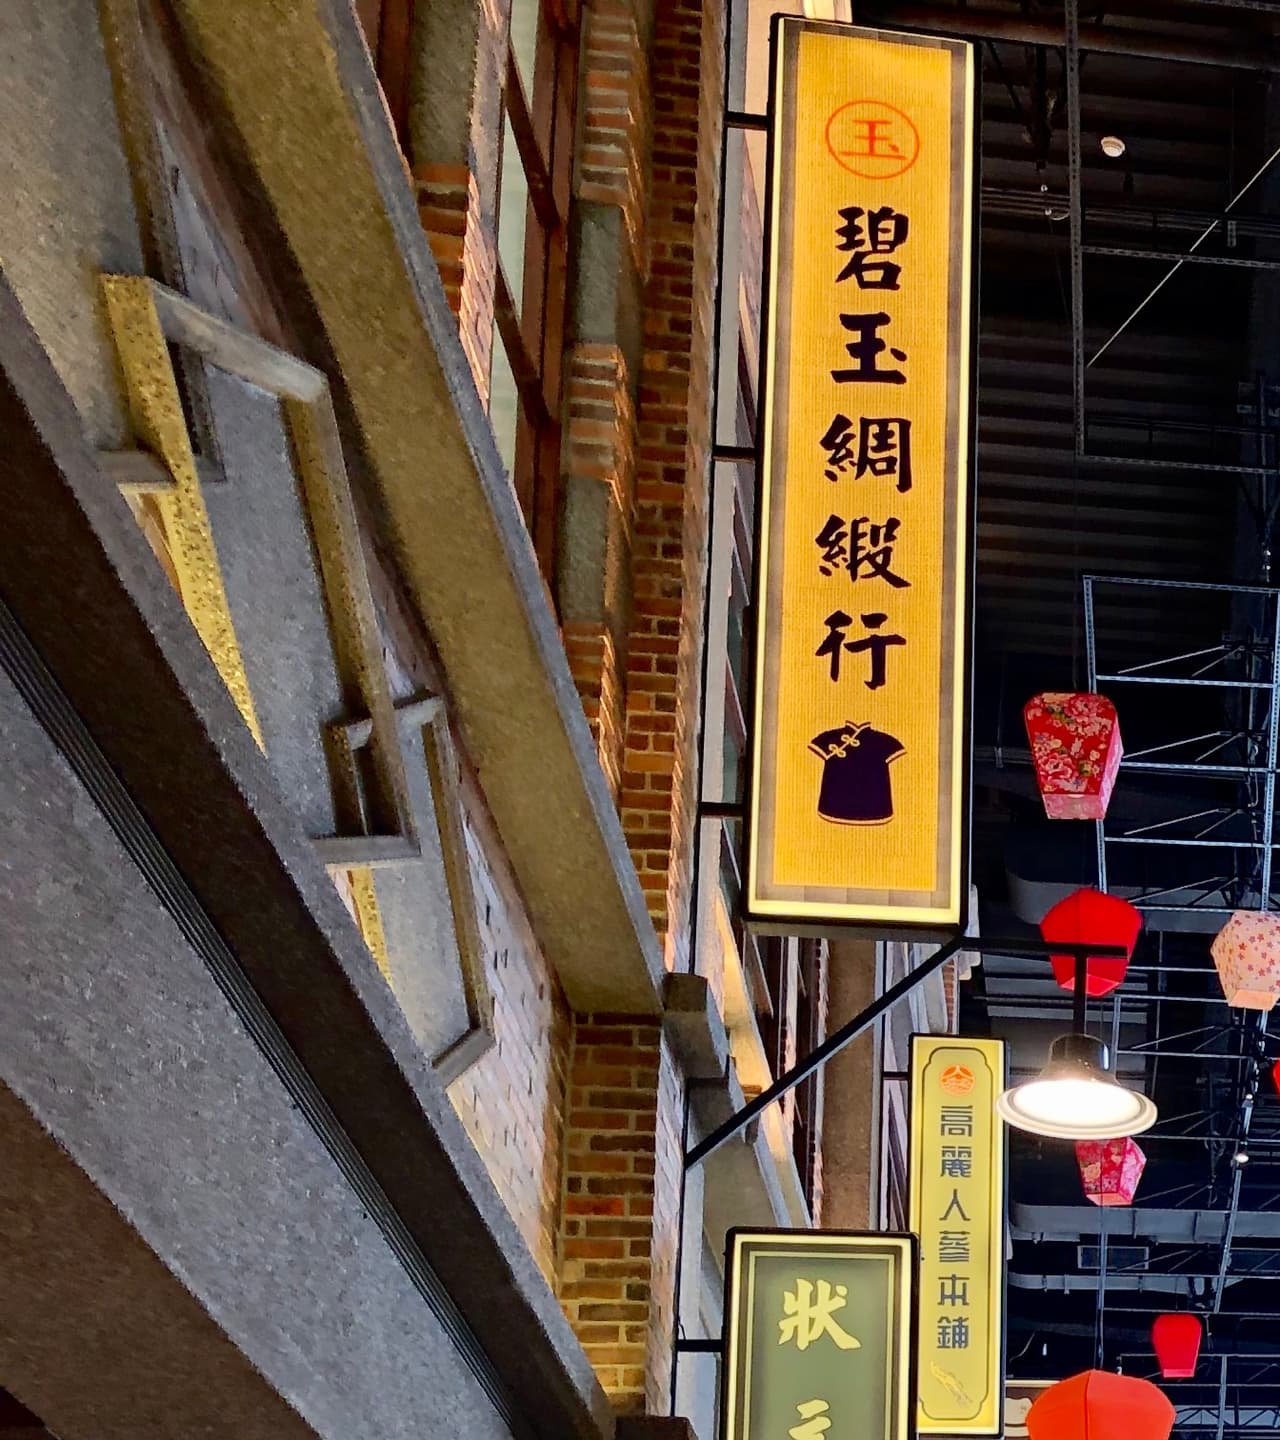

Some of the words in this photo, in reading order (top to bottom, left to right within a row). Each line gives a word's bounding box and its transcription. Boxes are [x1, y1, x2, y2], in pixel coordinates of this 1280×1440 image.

[814, 205, 914, 691] 碧玉綢緞行
